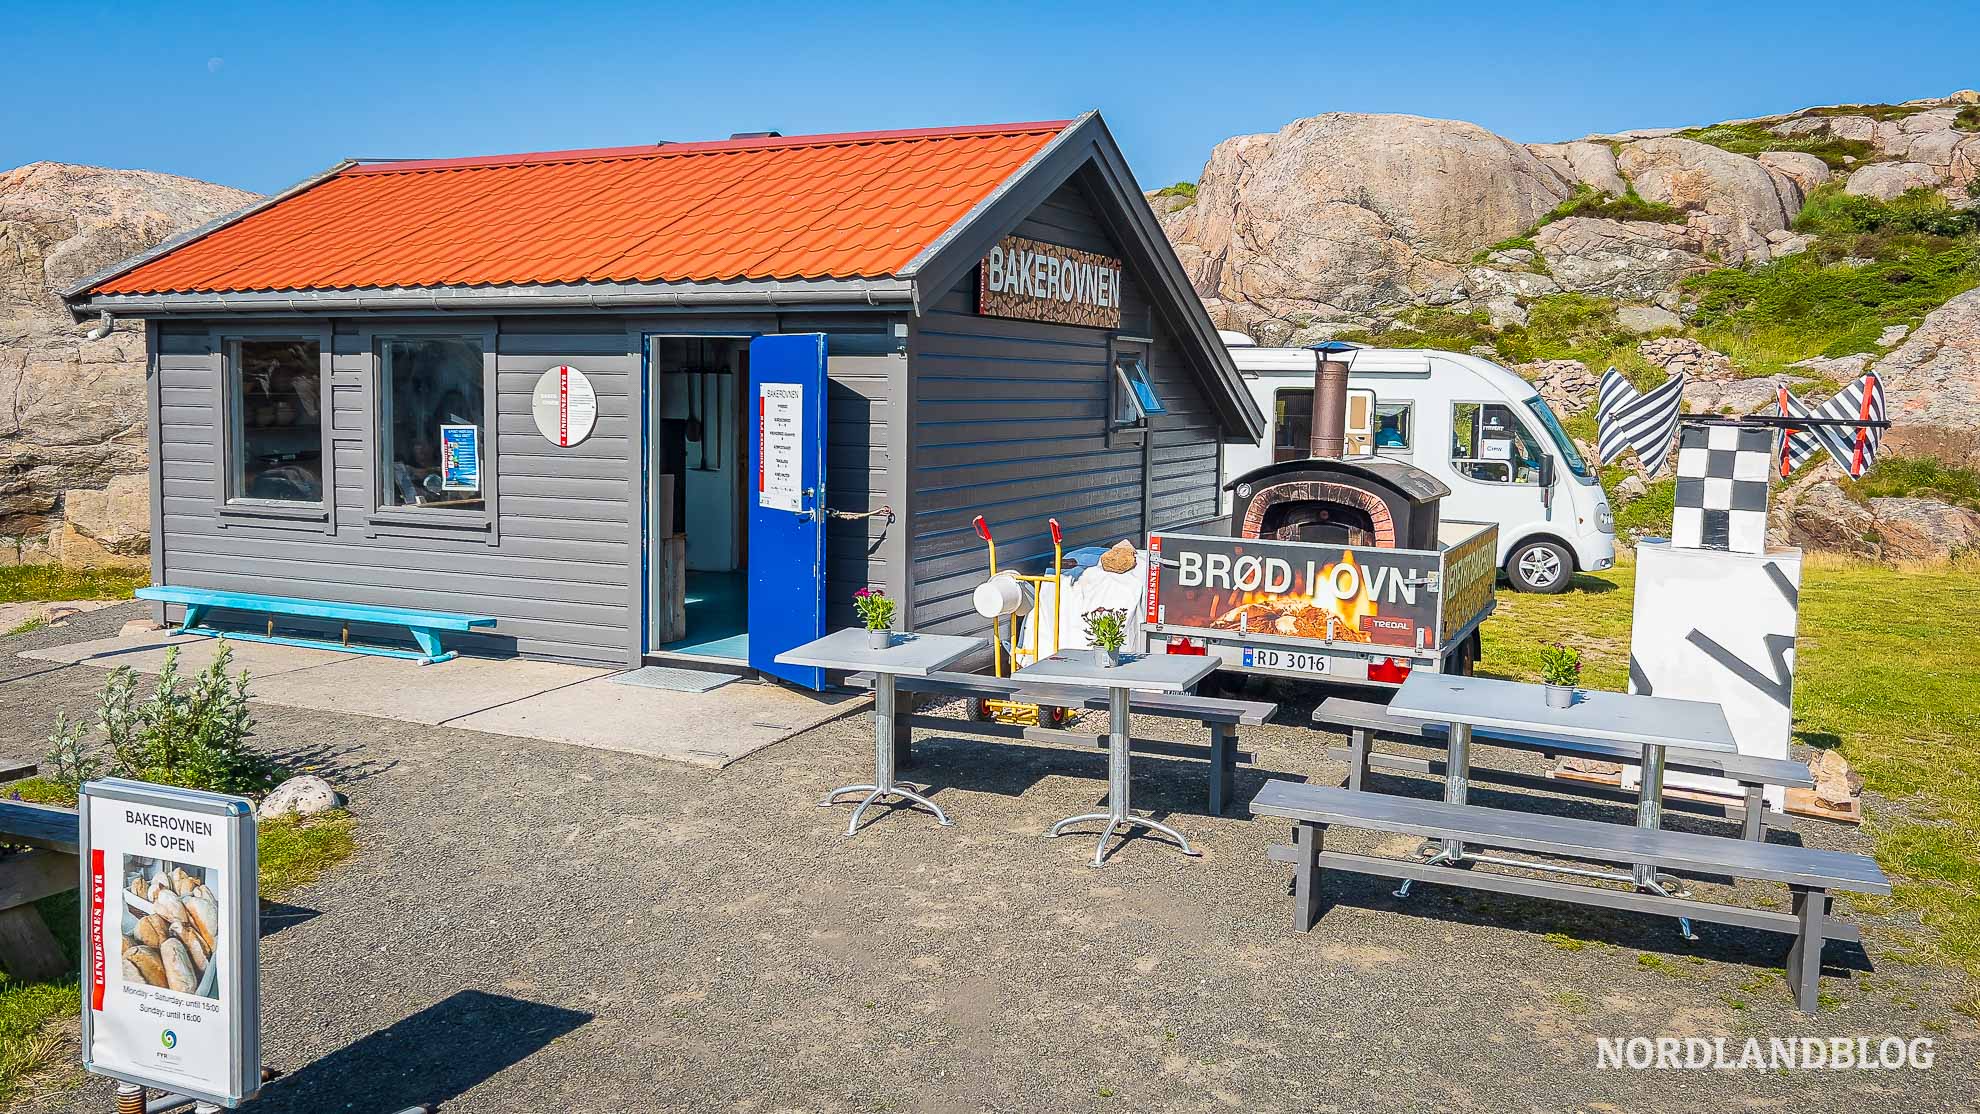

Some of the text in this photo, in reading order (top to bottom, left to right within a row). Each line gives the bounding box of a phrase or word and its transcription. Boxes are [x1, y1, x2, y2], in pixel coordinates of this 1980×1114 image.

[989, 245, 1120, 308] BAKEROVNEN
[1179, 551, 1292, 594] BRØD
[1306, 560, 1316, 596] I
[1330, 562, 1417, 605] OVN
[1257, 650, 1325, 671] RD 3016
[126, 810, 212, 837] BAKEROVNEN
[145, 833, 195, 853] IS OPEN
[94, 909, 104, 985] LINDESNES
[123, 985, 148, 999] Monday
[186, 1000, 201, 1009] until
[139, 1003, 165, 1017] Sunday:
[166, 1011, 181, 1019] until
